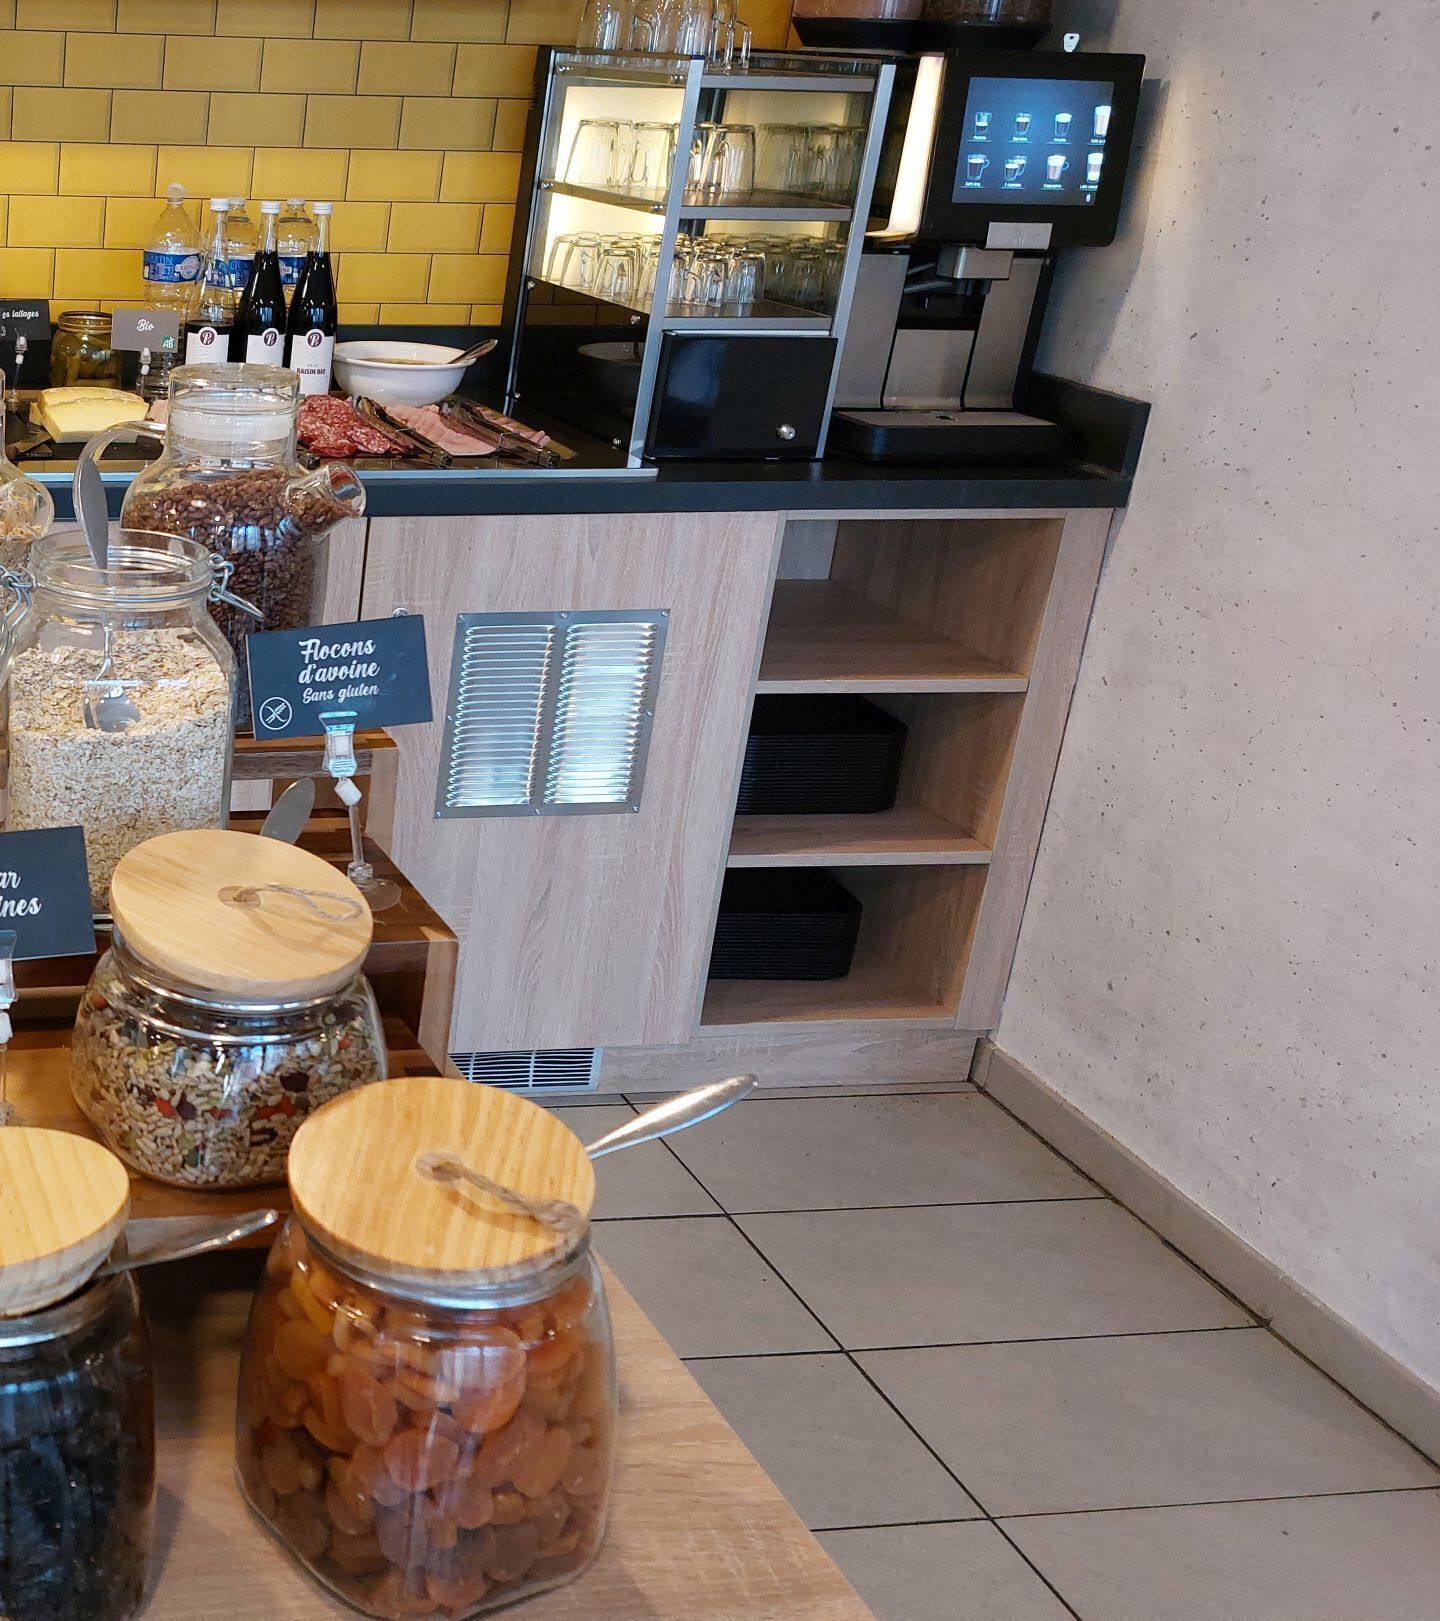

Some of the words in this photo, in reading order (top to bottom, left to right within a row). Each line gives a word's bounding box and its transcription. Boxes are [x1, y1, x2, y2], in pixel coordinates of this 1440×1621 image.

[2, 311, 11, 320] es
[11, 309, 40, 320] laitages
[136, 318, 156, 332] Bio
[162, 339, 174, 349] AB
[296, 367, 316, 375] RAISIN
[298, 638, 376, 664] Flocons
[298, 659, 381, 684] d'avoine
[302, 687, 335, 704] Sans
[337, 682, 380, 704] gluten
